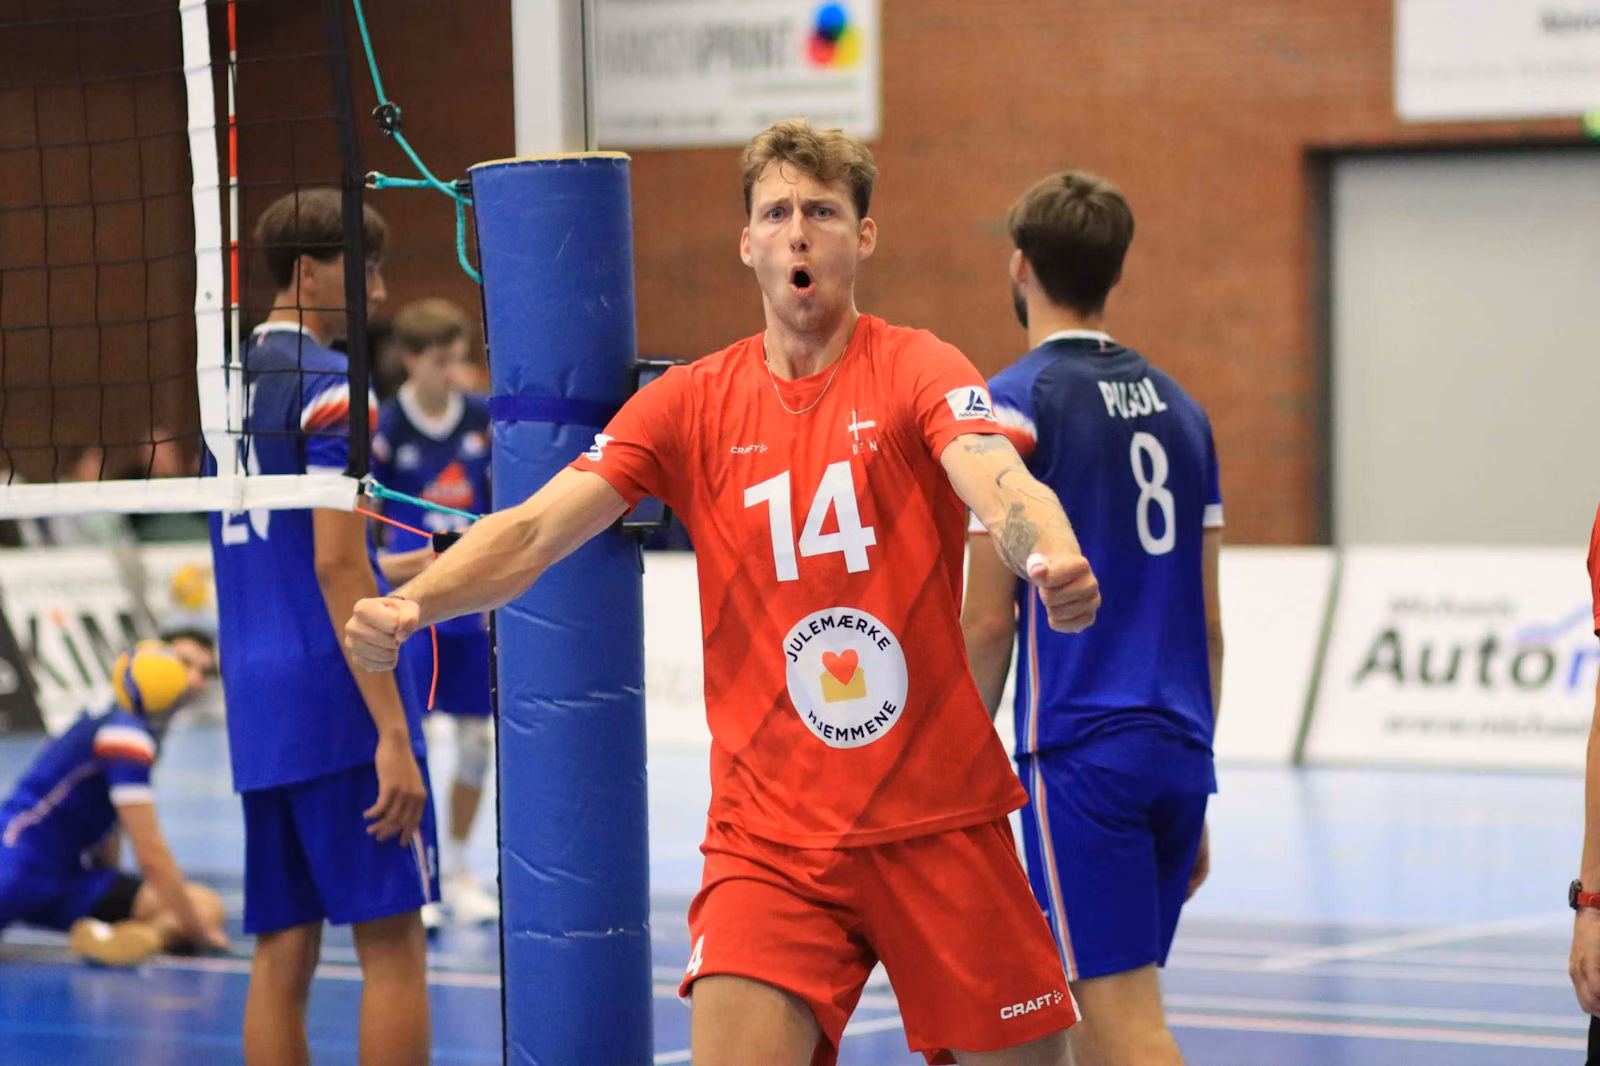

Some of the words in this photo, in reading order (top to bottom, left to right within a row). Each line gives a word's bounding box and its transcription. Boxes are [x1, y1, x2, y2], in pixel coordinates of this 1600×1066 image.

[730, 444, 760, 455] CRAFT
[1130, 431, 1176, 556] 8
[744, 460, 877, 582] 14
[787, 615, 891, 663] JULEMÆRKE
[808, 700, 897, 742] HJEMMENE
[686, 935, 704, 977] 4
[1000, 993, 1052, 1020] CRAFT
